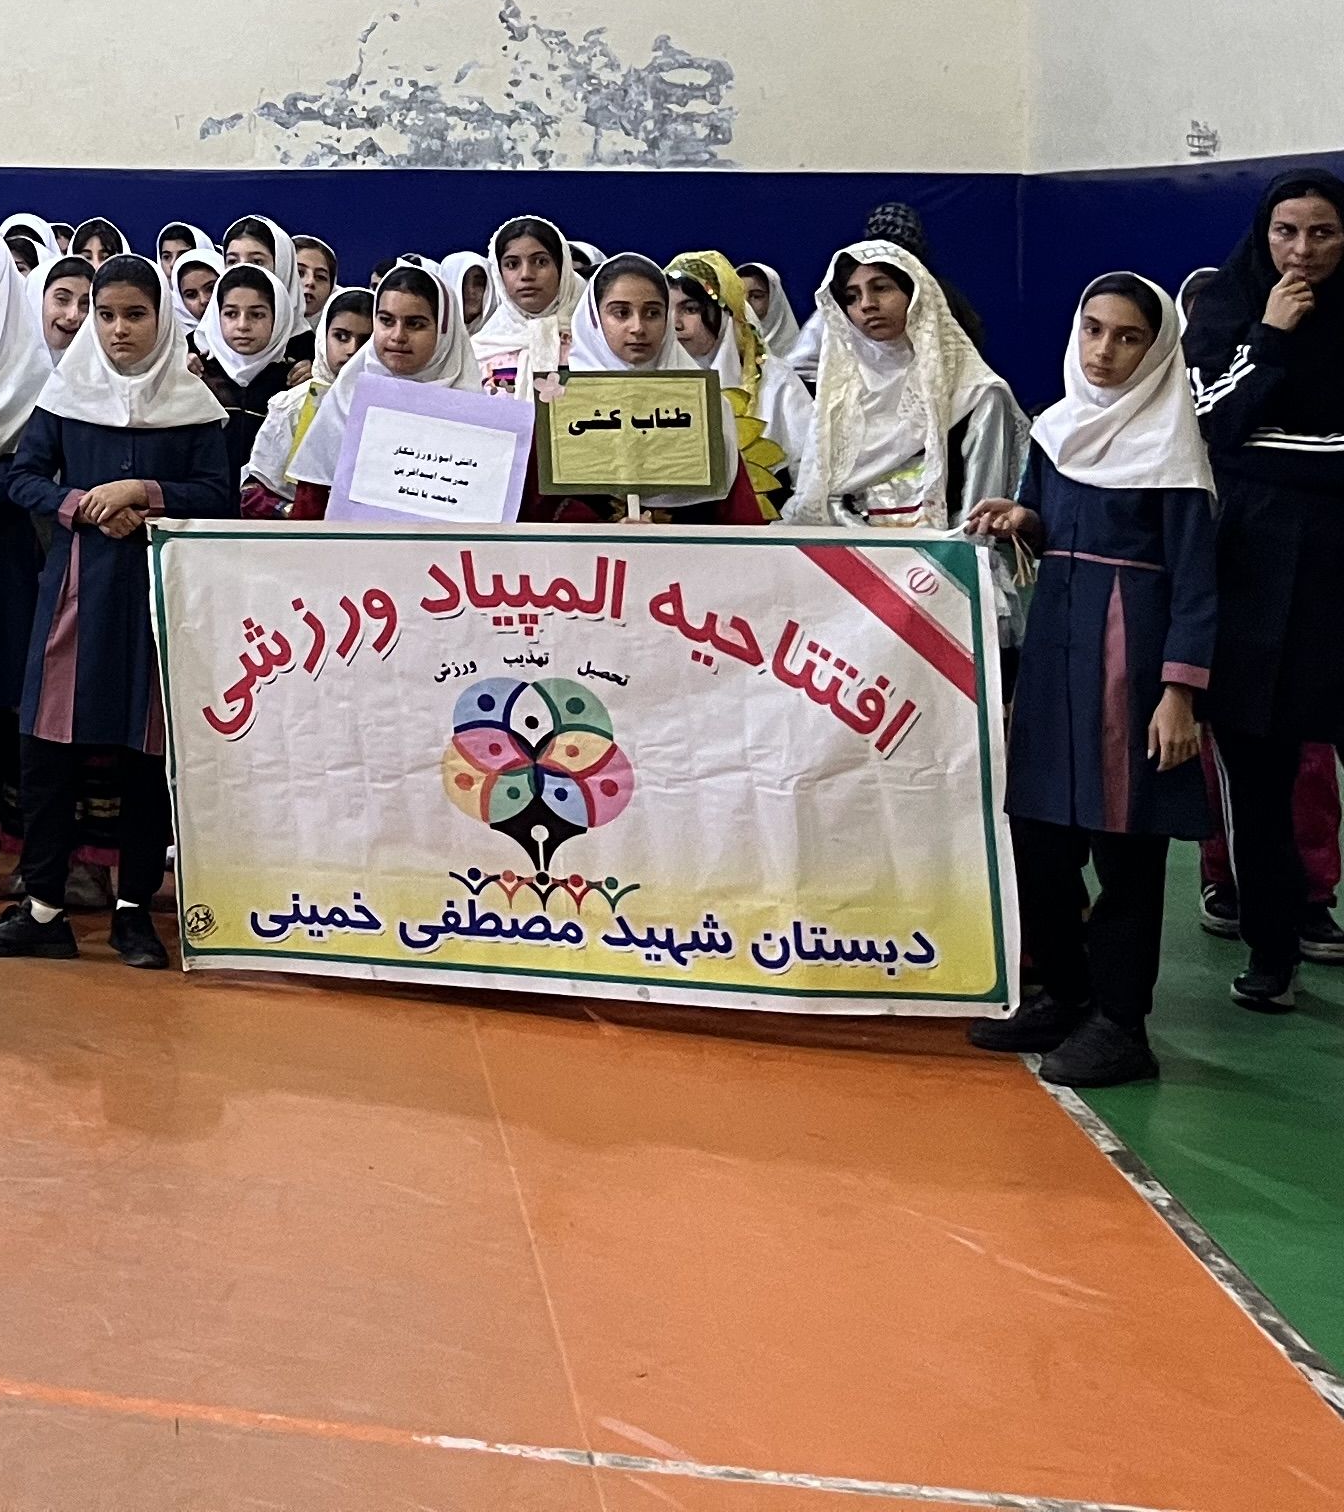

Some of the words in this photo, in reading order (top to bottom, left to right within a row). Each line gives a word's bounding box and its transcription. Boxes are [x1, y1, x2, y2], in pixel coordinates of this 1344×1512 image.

[567, 408, 622, 437] کشی
[631, 407, 692, 435] طناب
[421, 551, 627, 636] المپیاد
[202, 579, 399, 741] ورزشی
[434, 661, 477, 682] ورزش
[503, 650, 549, 668] تهذیب
[577, 660, 630, 686] تحصیل
[649, 582, 918, 755] افتتاحیه
[250, 889, 382, 942] خمینی
[399, 899, 584, 952] مصطفی
[609, 913, 732, 963] شهید
[752, 925, 937, 975] دبستان
